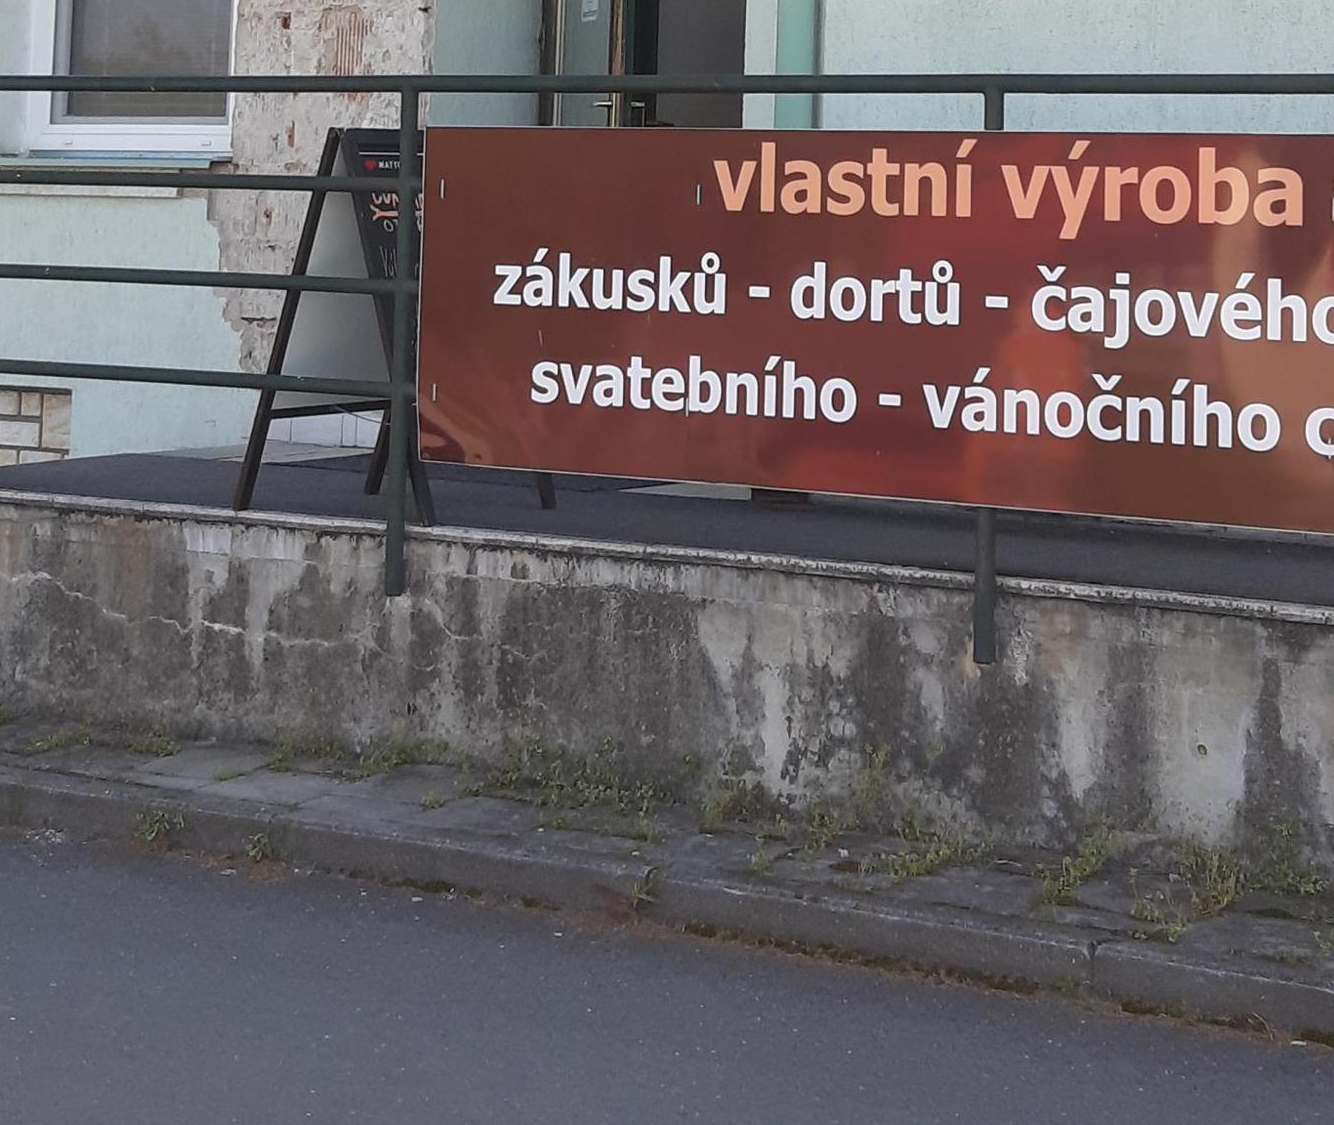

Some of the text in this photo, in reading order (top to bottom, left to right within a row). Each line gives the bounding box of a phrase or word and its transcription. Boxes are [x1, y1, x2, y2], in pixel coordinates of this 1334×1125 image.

[712, 137, 1304, 240] vlastní výroba
[492, 246, 727, 315] zákusků
[789, 259, 961, 326] dortů
[530, 354, 858, 424] svatebního
[921, 366, 1282, 453] vánočního
